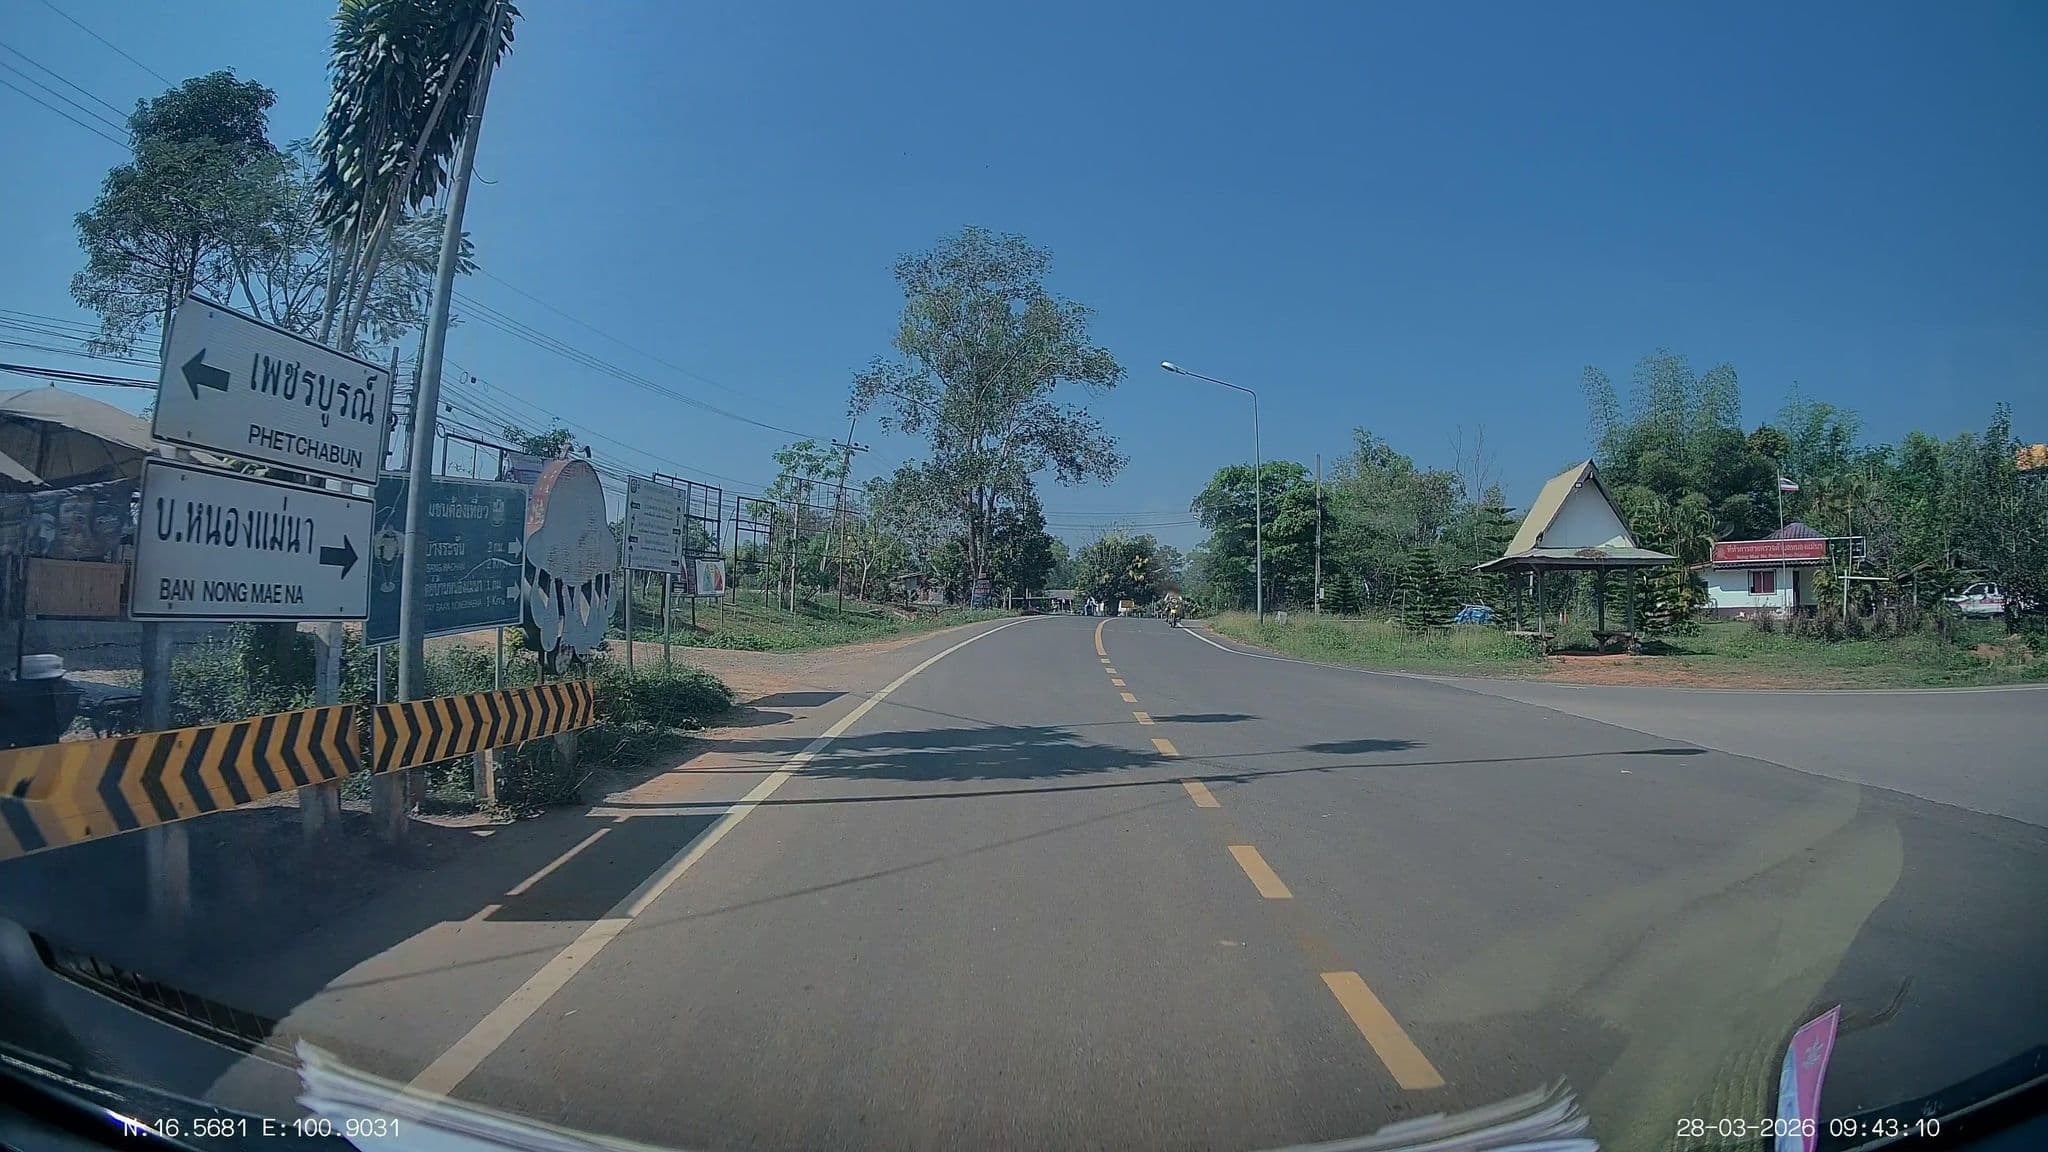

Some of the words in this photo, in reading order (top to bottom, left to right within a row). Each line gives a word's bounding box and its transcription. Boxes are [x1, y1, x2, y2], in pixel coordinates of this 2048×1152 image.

[250, 352, 378, 428] เพชรบูรณ์
[248, 424, 363, 470] PHETCHABUN
[156, 496, 315, 556] บ.หนองแม่นา
[159, 577, 195, 602] BAN
[203, 580, 248, 603] NONG
[251, 583, 282, 604] MAE
[284, 585, 304, 605] NA
